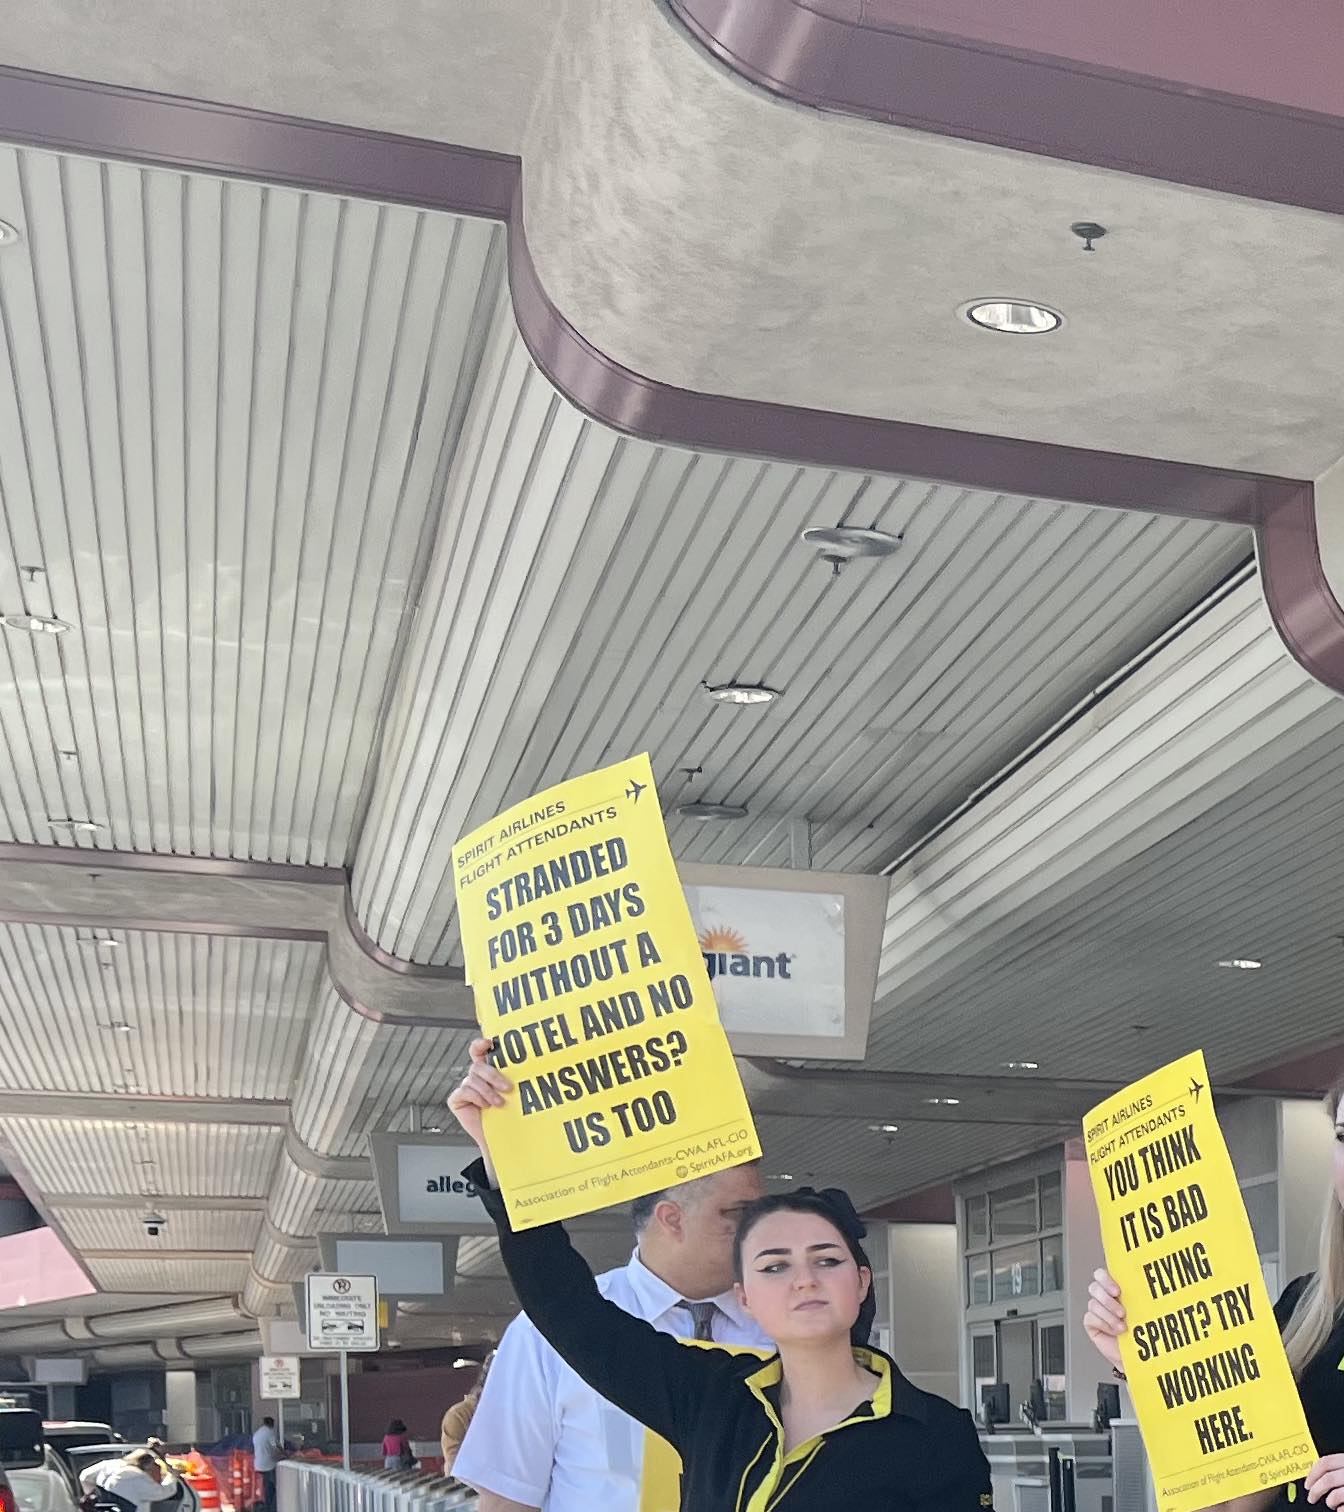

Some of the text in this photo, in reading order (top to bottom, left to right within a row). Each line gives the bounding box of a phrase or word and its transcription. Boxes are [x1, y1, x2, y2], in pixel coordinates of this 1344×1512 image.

[457, 801, 566, 868] SPIRIT AIRLINES
[460, 807, 617, 889] FLIGHT ATTENDANTS
[485, 836, 629, 921] STRANDED
[488, 882, 646, 971] FOR 3 DAYS
[492, 932, 661, 1017] WITHOUT A
[488, 974, 694, 1069] HOTEL AND NO
[518, 1030, 688, 1116] ANSWERS?
[562, 1090, 678, 1154] US TOO
[1087, 1095, 1153, 1142] SPIRIT AIRLINES
[1090, 1105, 1186, 1165] FLIGHT ATTENDANTS
[514, 1186, 576, 1209] Association
[578, 1180, 589, 1193] of
[590, 1172, 620, 1189] Flight
[1103, 1123, 1202, 1201] YOU THINK
[1119, 1183, 1208, 1252] IT IS BAD
[1142, 1242, 1213, 1300] FLYING
[1133, 1283, 1256, 1362] SPIRIT? TRY
[1156, 1342, 1261, 1410] WORKING
[1194, 1404, 1255, 1456] HERE.
